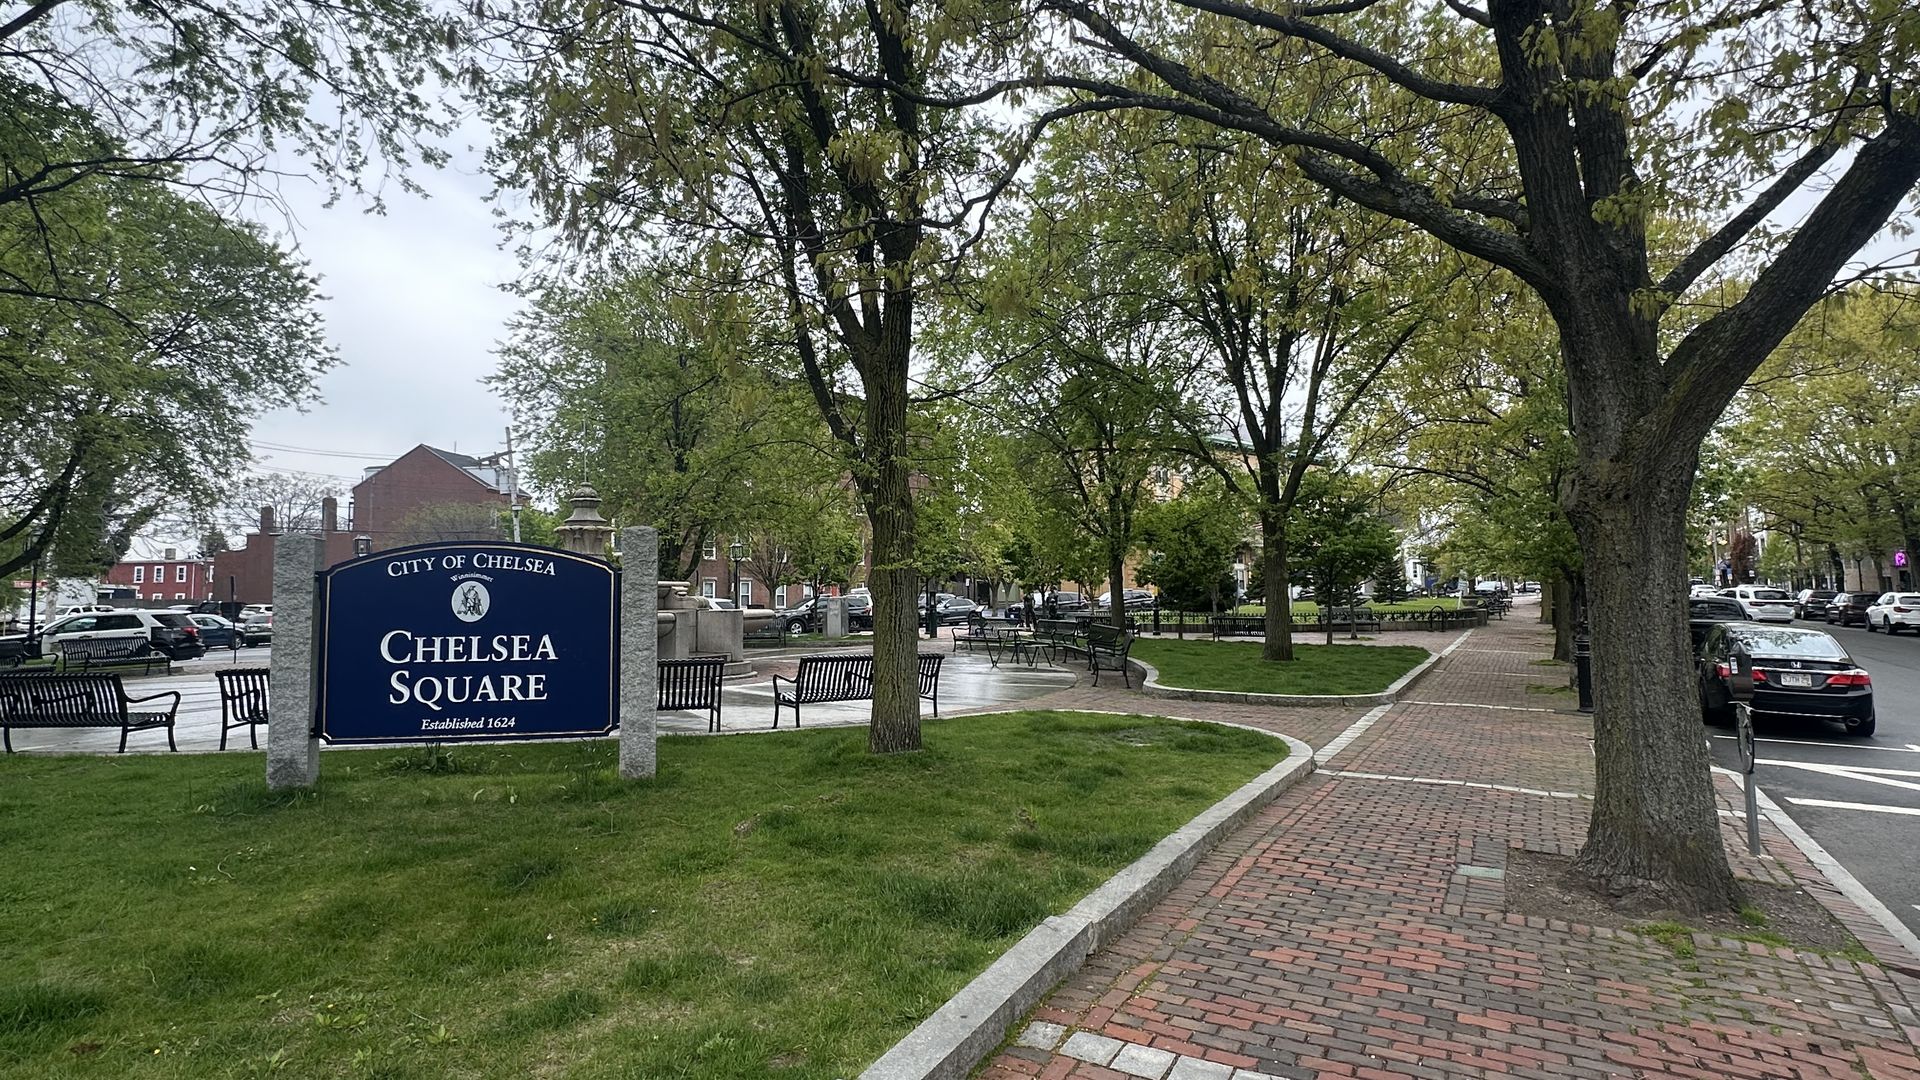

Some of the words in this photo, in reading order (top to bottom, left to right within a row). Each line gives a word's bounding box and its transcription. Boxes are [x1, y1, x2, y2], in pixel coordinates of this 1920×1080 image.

[387, 557, 436, 577] CITY
[442, 555, 467, 570] OF
[472, 552, 557, 577] CHELSEA
[380, 630, 559, 664] CHELSEA
[389, 670, 549, 711] SQUARE
[421, 717, 485, 730] Established
[488, 717, 516, 729] 1624
